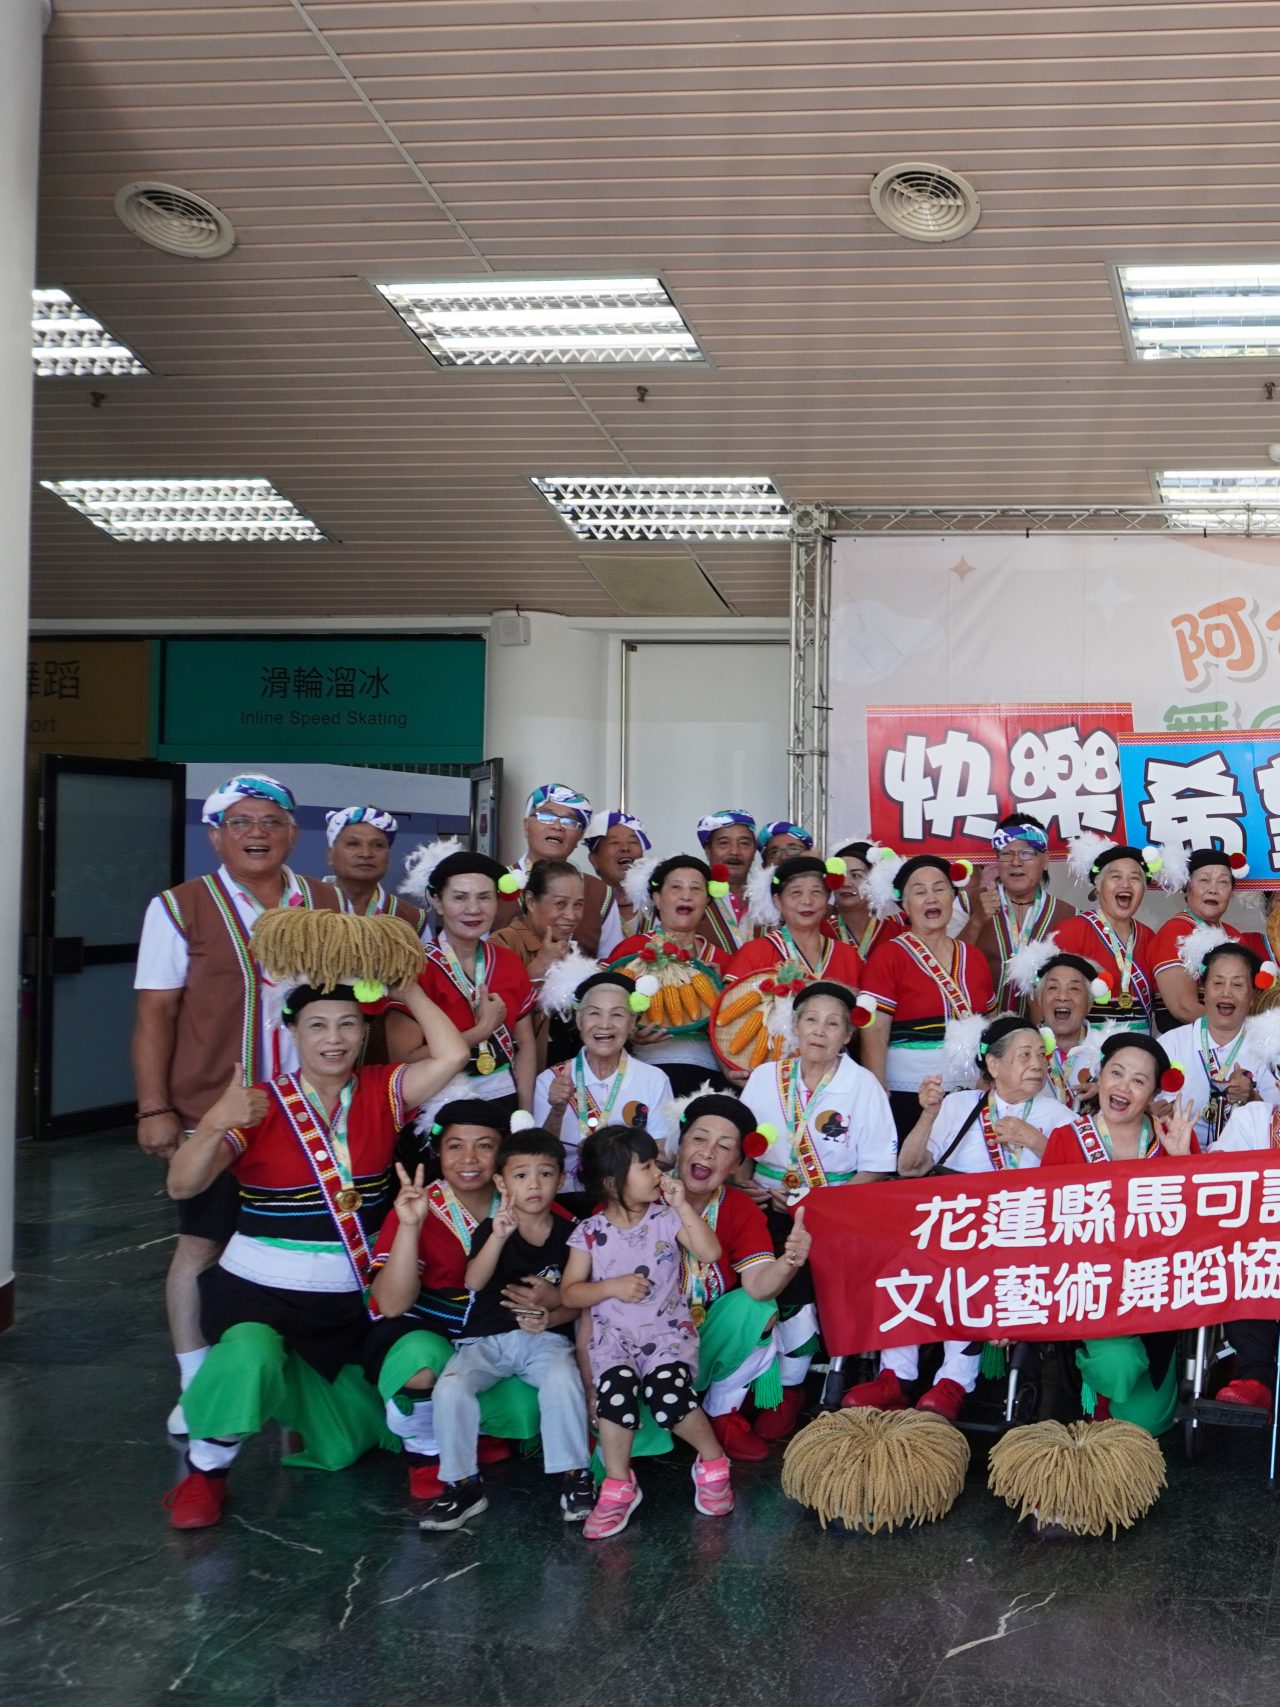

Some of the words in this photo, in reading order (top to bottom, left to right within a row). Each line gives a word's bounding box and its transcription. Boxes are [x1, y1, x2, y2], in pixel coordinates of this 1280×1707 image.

[259, 666, 390, 699] 滑輪溜冰
[240, 710, 284, 725] Inline
[290, 710, 341, 728] Speed
[347, 710, 408, 729] Skating
[883, 726, 1121, 842] 快樂
